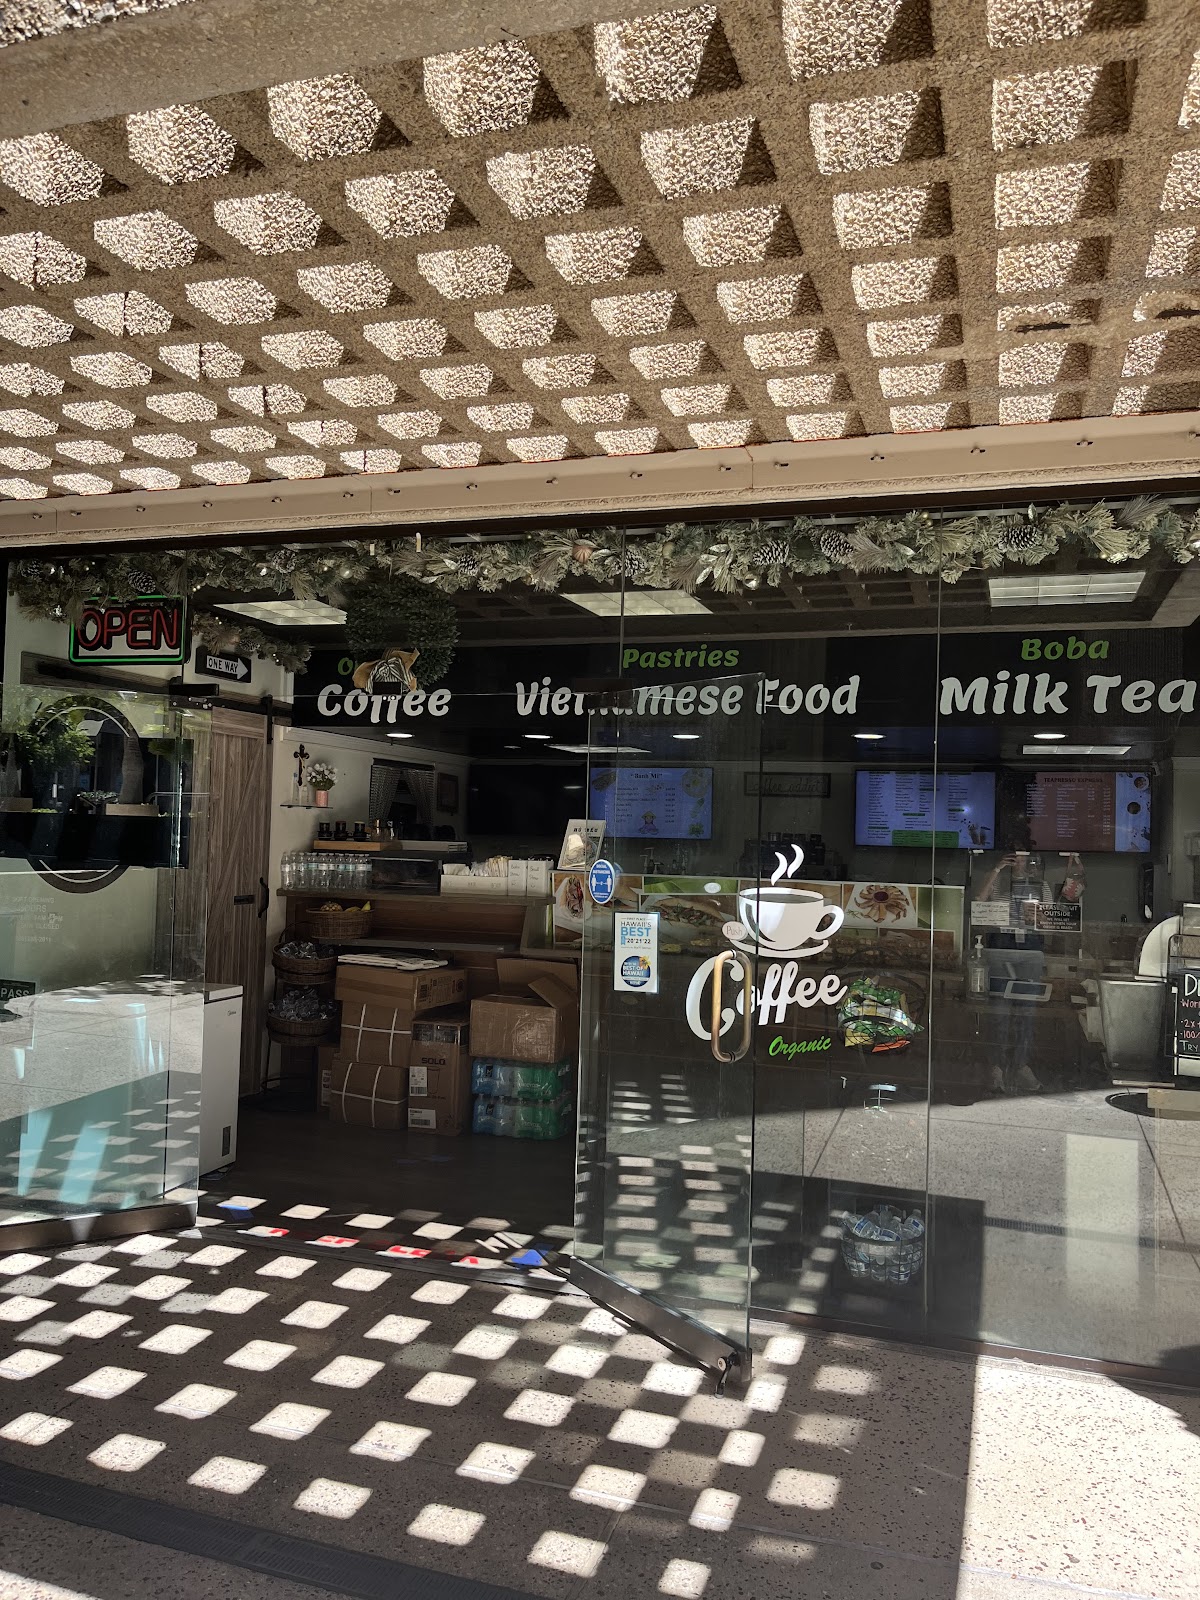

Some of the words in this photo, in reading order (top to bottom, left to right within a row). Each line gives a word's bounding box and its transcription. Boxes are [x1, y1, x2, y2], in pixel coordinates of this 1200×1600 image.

[77, 607, 179, 648] OPEN
[622, 643, 740, 669] Pastries
[1020, 635, 1110, 661] Boba
[208, 656, 222, 670] ONE
[224, 660, 238, 674] WAY
[515, 676, 744, 716] Vietmese
[756, 674, 861, 716] Food
[939, 669, 1069, 716] Milk
[1086, 674, 1198, 714] Tea
[620, 927, 652, 937] BEST
[725, 925, 743, 936] Push
[1184, 973, 1200, 996] D
[686, 955, 848, 1041] Coffee
[768, 1035, 832, 1061] Organic
[421, 1057, 446, 1066] SOLO
